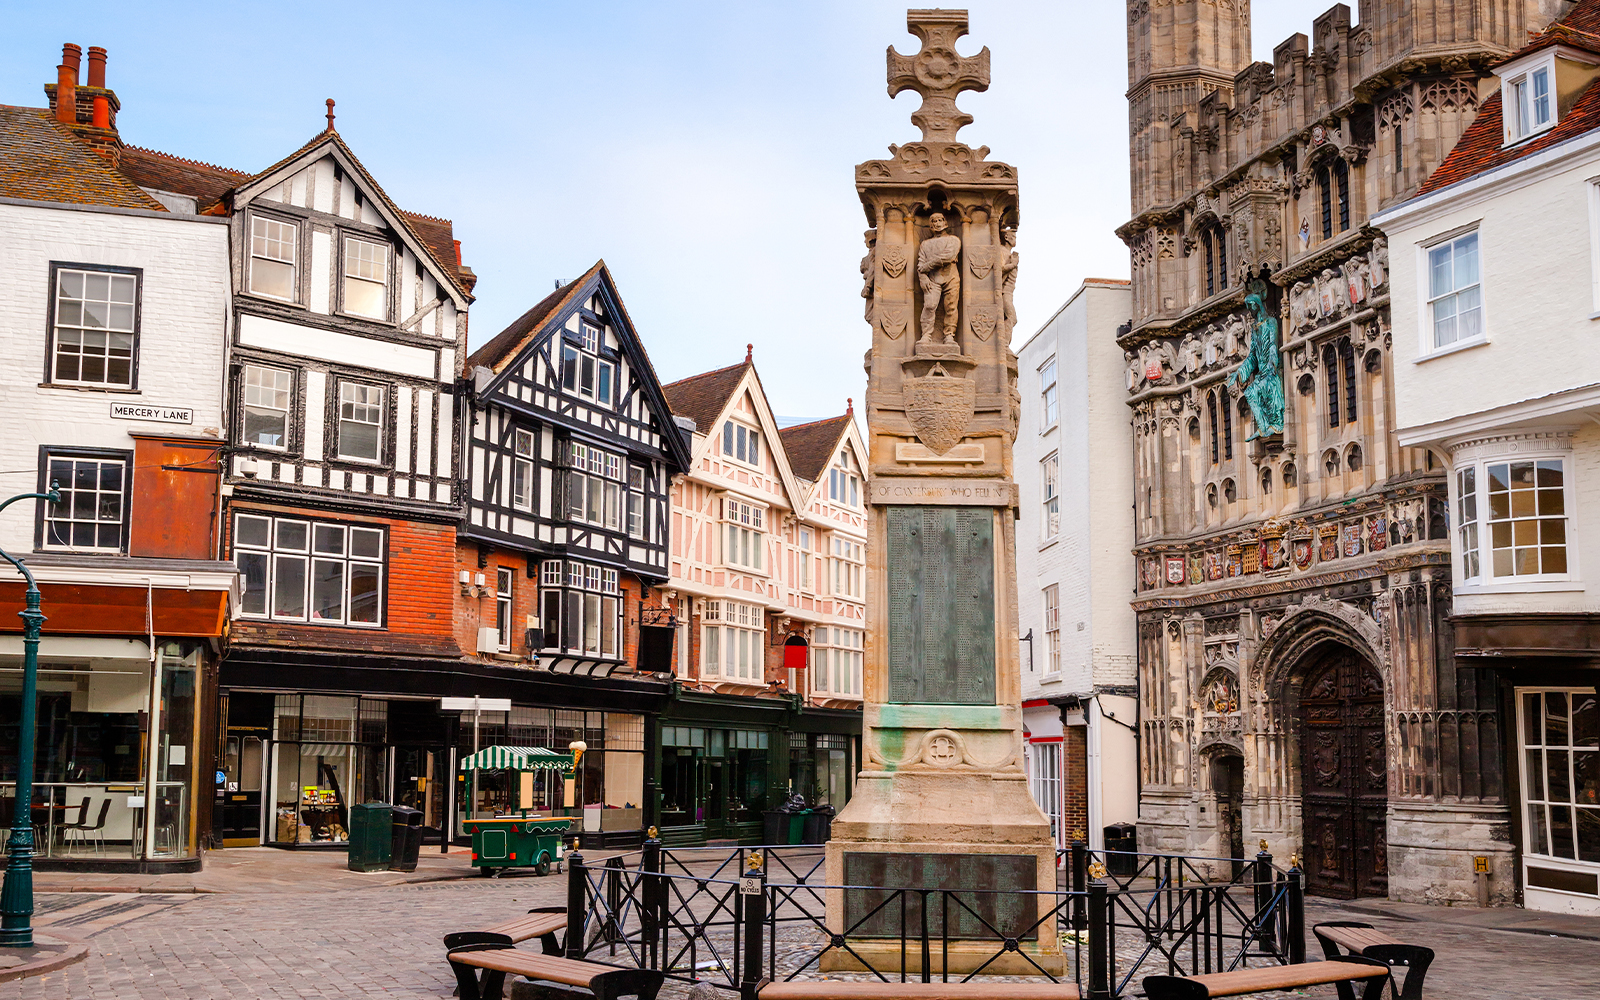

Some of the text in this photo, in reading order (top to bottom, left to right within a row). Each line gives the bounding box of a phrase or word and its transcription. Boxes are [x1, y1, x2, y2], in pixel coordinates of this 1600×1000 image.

[115, 407, 189, 420] MERCERY LANE
[1476, 858, 1487, 871] H
